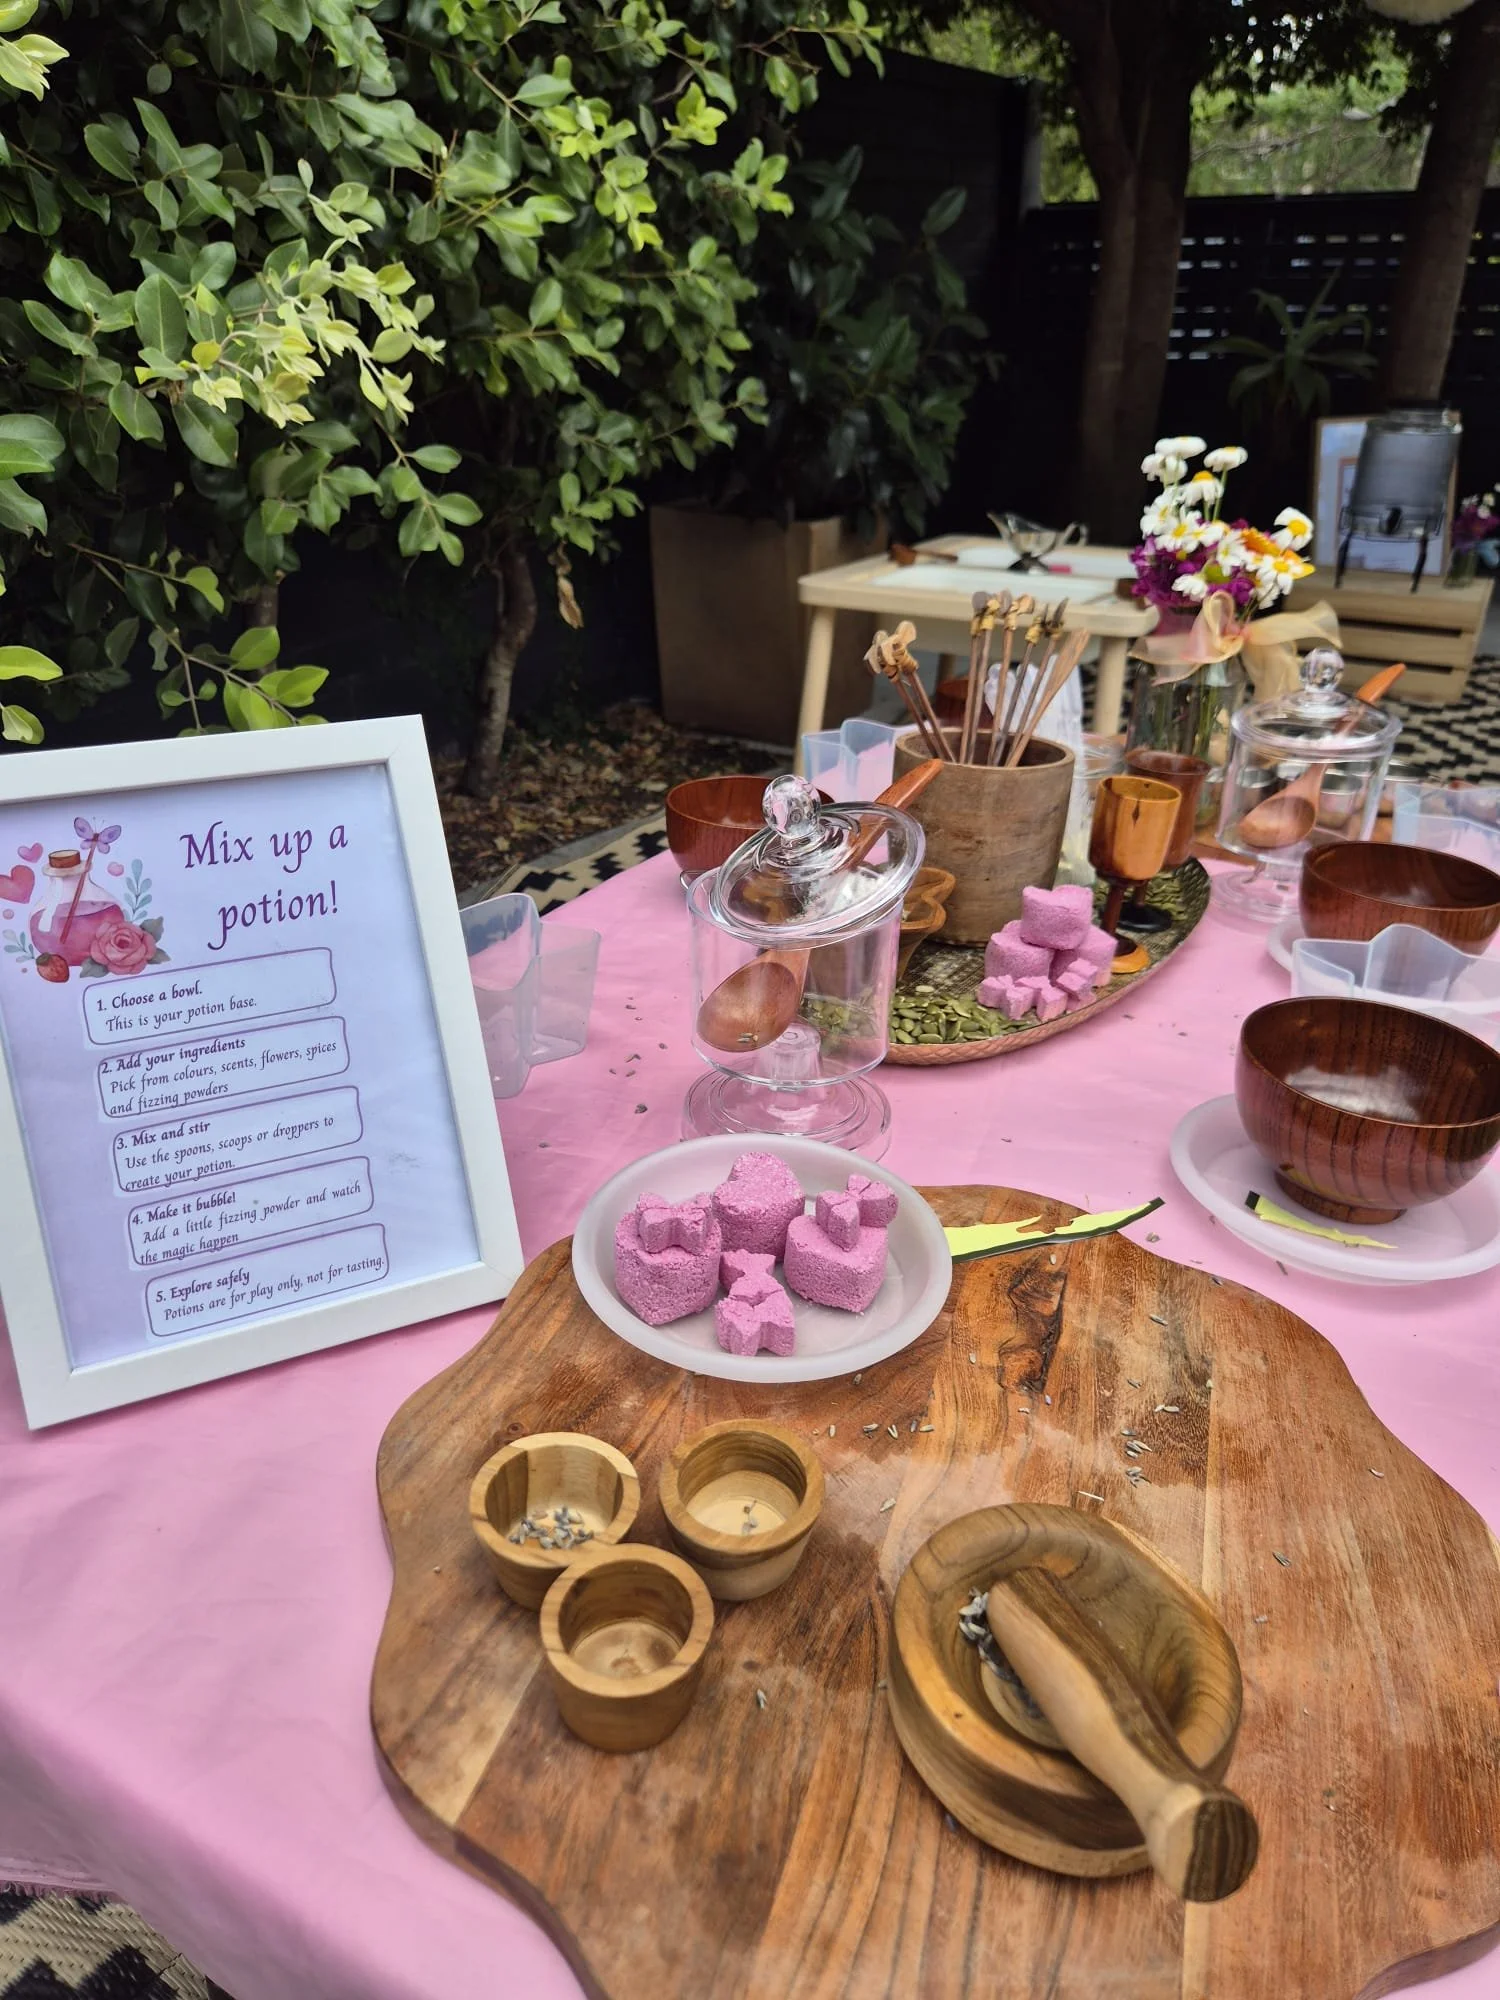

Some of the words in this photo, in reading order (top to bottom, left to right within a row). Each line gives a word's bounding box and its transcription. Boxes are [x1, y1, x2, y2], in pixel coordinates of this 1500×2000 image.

[180, 821, 254, 869] Mix
[270, 829, 313, 873] up
[329, 824, 349, 850] a
[207, 880, 339, 951] potion!
[97, 998, 107, 1011] 1.
[112, 992, 154, 1010] Choose
[158, 992, 167, 1001] a
[171, 980, 202, 999] bowl.
[105, 1015, 133, 1032] This
[139, 1014, 149, 1026] is
[153, 1010, 183, 1029] your
[183, 1000, 225, 1024] potion
[229, 996, 257, 1010] base.
[101, 1062, 112, 1074] 2.
[116, 1054, 141, 1072] Add
[145, 1050, 175, 1071] your
[179, 1037, 246, 1063] ingredients
[110, 1076, 136, 1093] Pick
[140, 1075, 169, 1093] from
[173, 1064, 217, 1082] colours,
[221, 1056, 257, 1072] scents,
[260, 1048, 302, 1070] flowers,
[306, 1041, 337, 1060] spices
[110, 1100, 133, 1115] and
[137, 1092, 179, 1116] fizzing
[183, 1081, 229, 1105] powders
[116, 1137, 128, 1150] 3.
[132, 1129, 157, 1146] Mix
[161, 1122, 185, 1140] and
[188, 1121, 211, 1135] stir
[124, 1156, 147, 1169] Use
[152, 1148, 170, 1164] the
[174, 1143, 215, 1165] spoons,
[218, 1134, 253, 1151] scoops
[257, 1131, 269, 1141] or
[273, 1120, 320, 1140] droppers
[324, 1116, 334, 1127] to
[125, 1174, 160, 1191] create
[164, 1168, 192, 1187] your
[192, 1159, 236, 1181] potion.
[132, 1214, 143, 1225] 4.
[147, 1203, 178, 1222] Make
[182, 1202, 192, 1214] it
[196, 1191, 236, 1212] bubble!
[143, 1225, 166, 1244] Add
[172, 1227, 179, 1237] a
[186, 1215, 213, 1234] little
[218, 1209, 257, 1231] fizzing
[260, 1196, 300, 1221] powder
[306, 1188, 326, 1205] and
[331, 1180, 361, 1197] watch
[140, 1252, 158, 1265] the
[162, 1243, 195, 1260] magic
[199, 1233, 239, 1252] happen
[155, 1290, 167, 1303] 5.
[170, 1278, 213, 1301] Explore
[216, 1267, 250, 1289] safely
[164, 1302, 205, 1320] Potions
[208, 1297, 226, 1308] are
[229, 1291, 247, 1309] for
[249, 1283, 273, 1304] play
[277, 1274, 303, 1292] only,
[307, 1272, 323, 1284] not
[327, 1264, 343, 1283] for
[347, 1255, 385, 1272] tasting.
